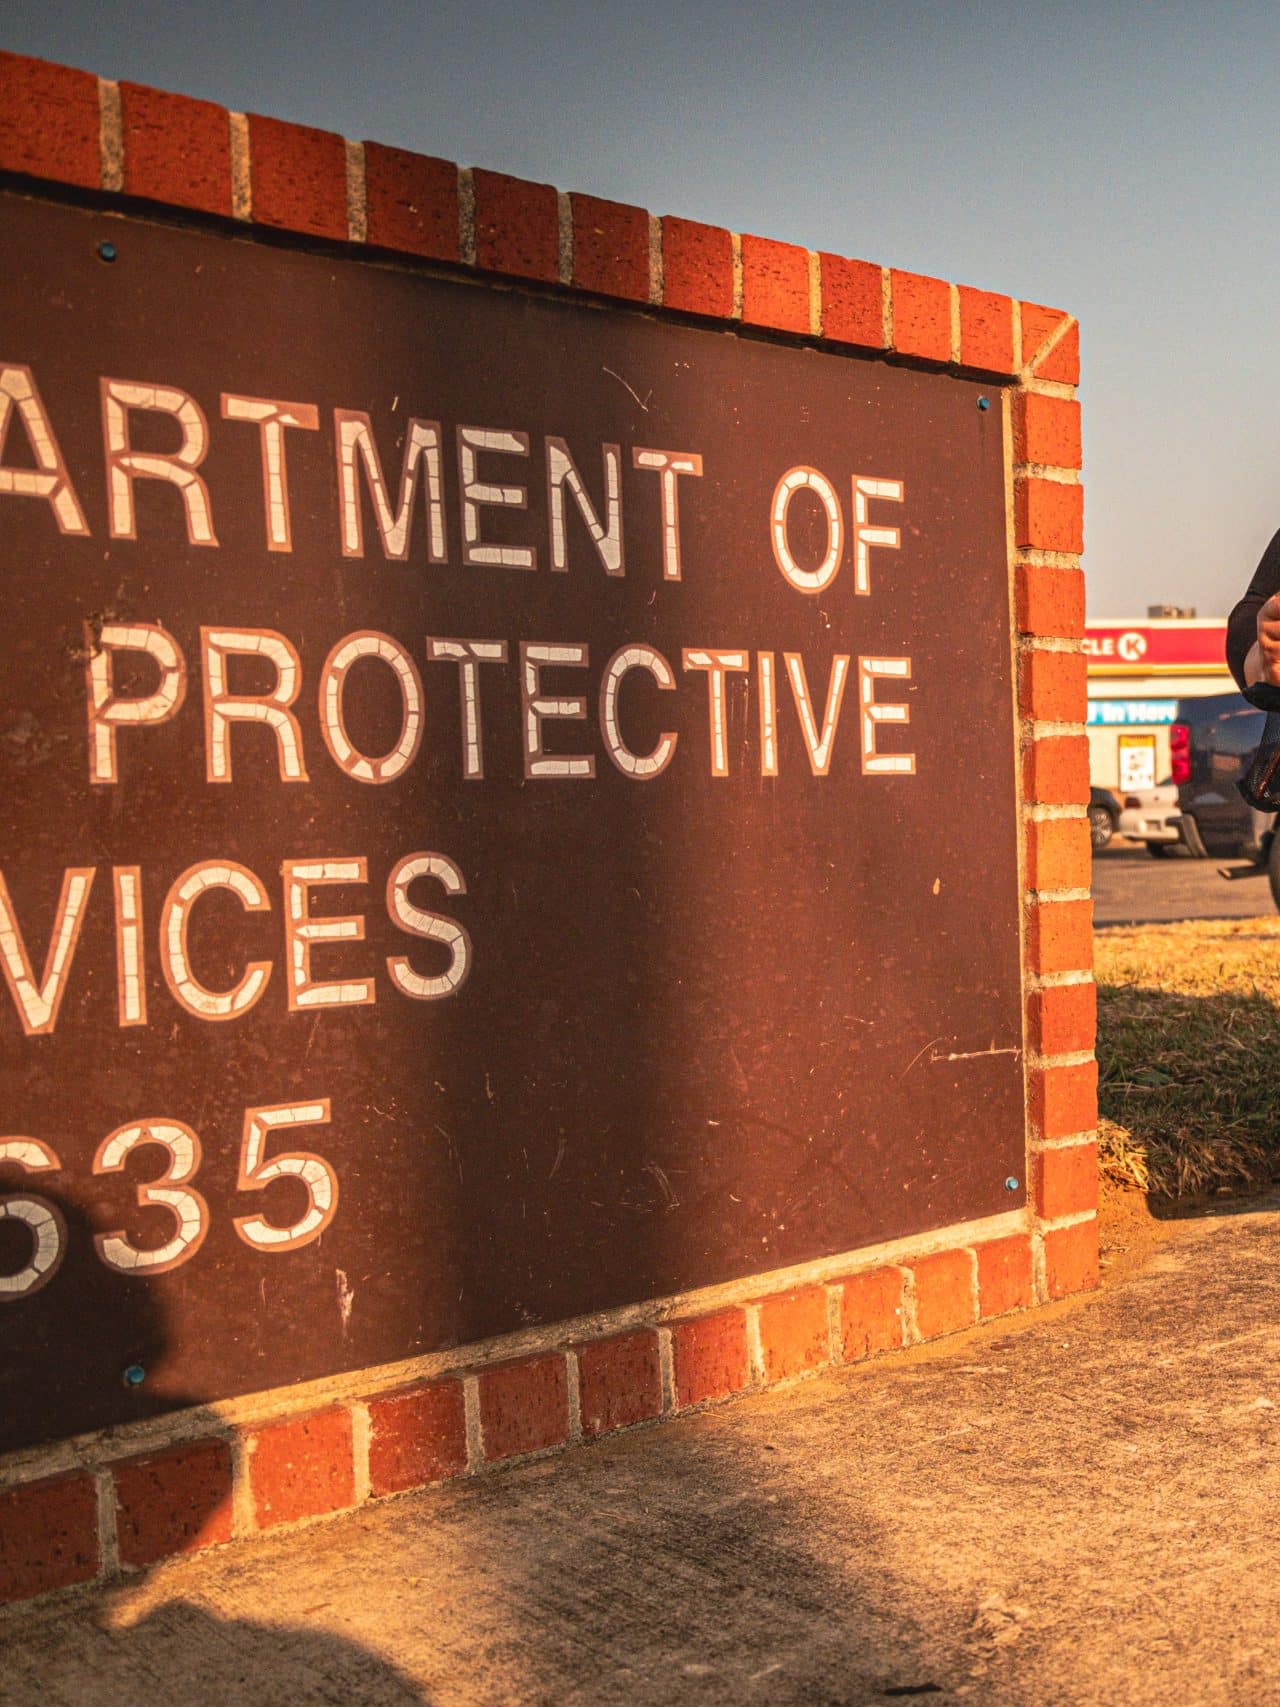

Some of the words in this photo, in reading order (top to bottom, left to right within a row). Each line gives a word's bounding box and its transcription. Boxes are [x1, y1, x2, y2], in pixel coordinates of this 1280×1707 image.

[0, 362, 703, 581] ARTMENT
[770, 464, 904, 596] OF
[86, 621, 917, 784] PROTECTIVE
